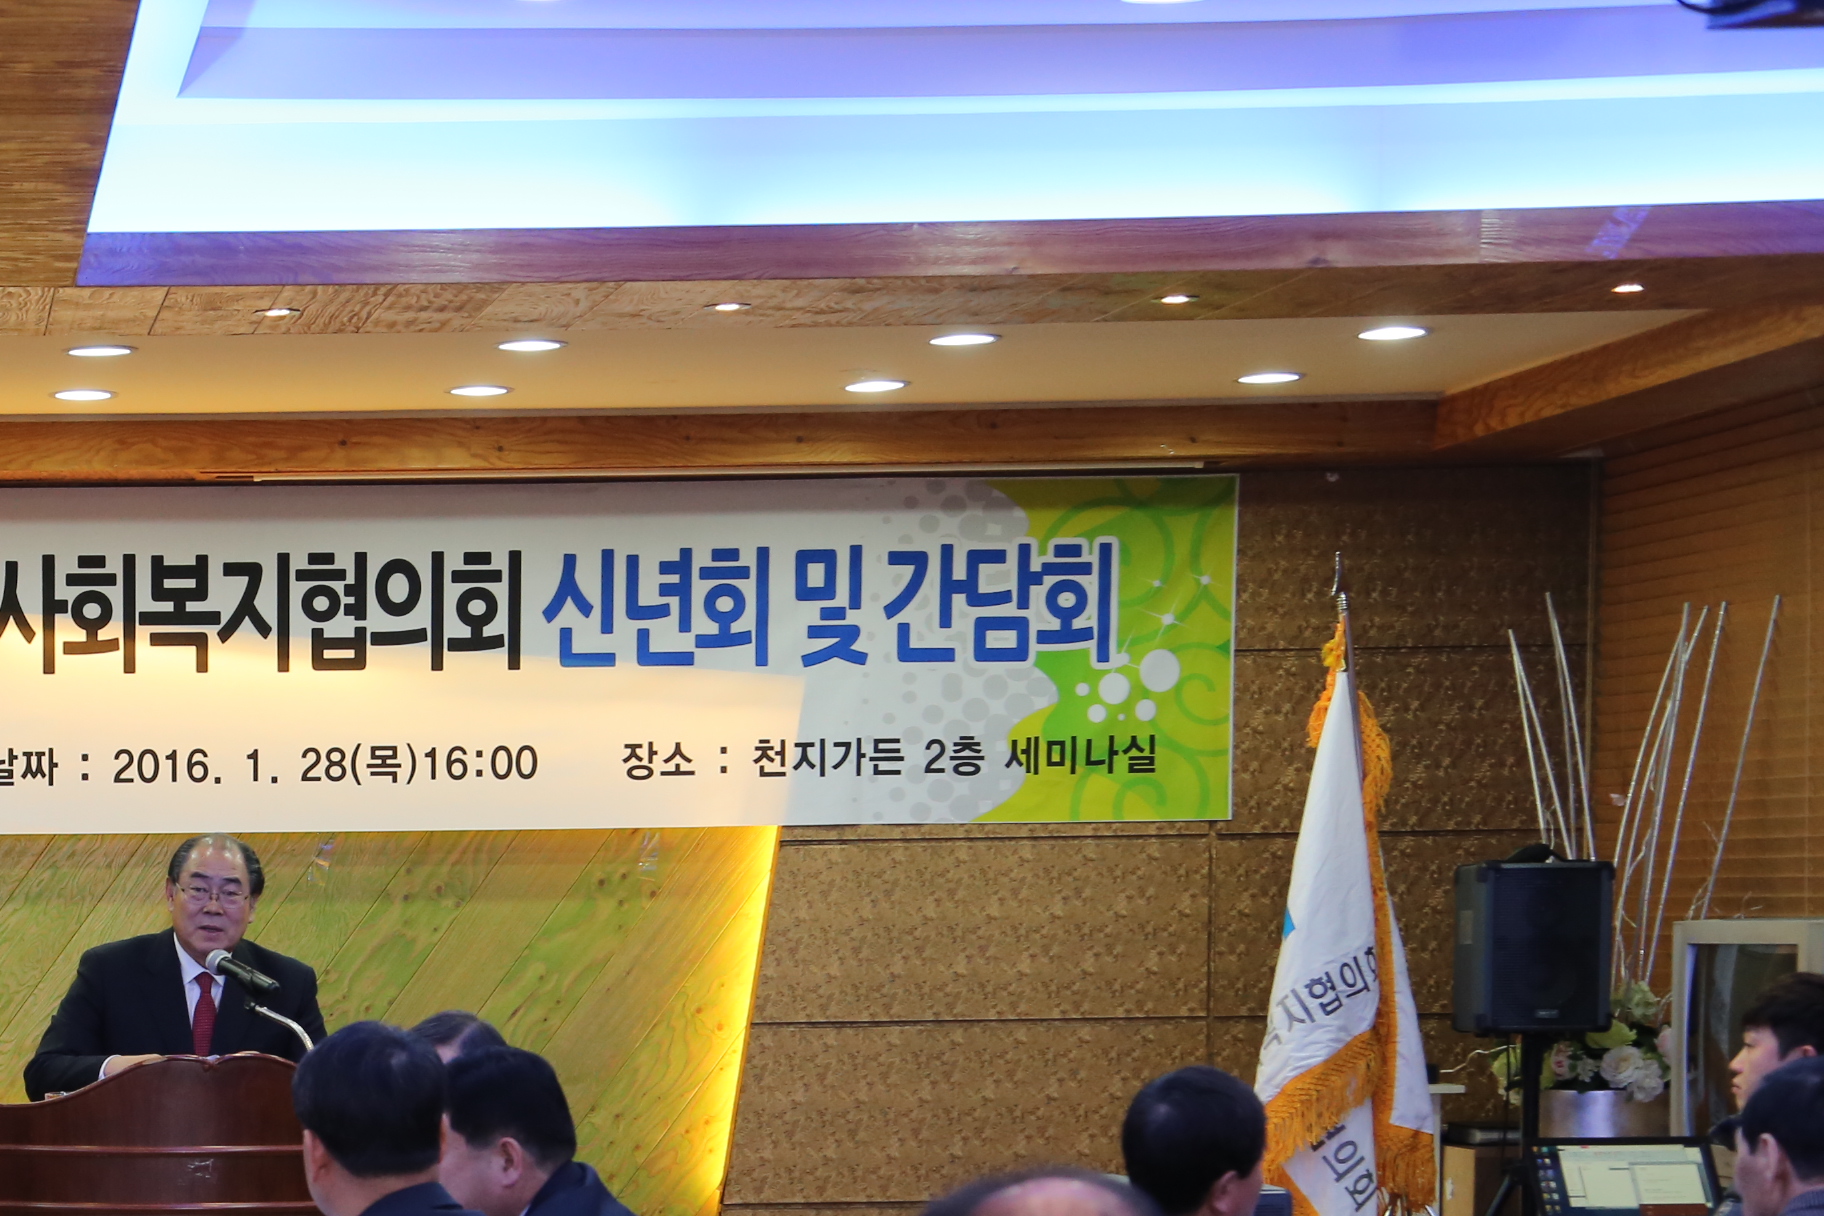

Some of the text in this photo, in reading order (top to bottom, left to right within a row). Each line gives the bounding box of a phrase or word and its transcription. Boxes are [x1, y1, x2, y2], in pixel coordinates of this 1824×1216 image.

[542, 546, 770, 668] 신년회
[794, 545, 868, 668] 및
[883, 542, 1118, 665] 간담회
[113, 748, 222, 785] 2016.
[246, 748, 279, 785] 1.
[301, 743, 539, 787] 28(목)16:00
[621, 741, 696, 782] 장소
[753, 736, 906, 779] 천지가든
[924, 735, 986, 777] 2층
[1004, 734, 1159, 776] 세미나실
[1263, 946, 1377, 1050] 지협의
